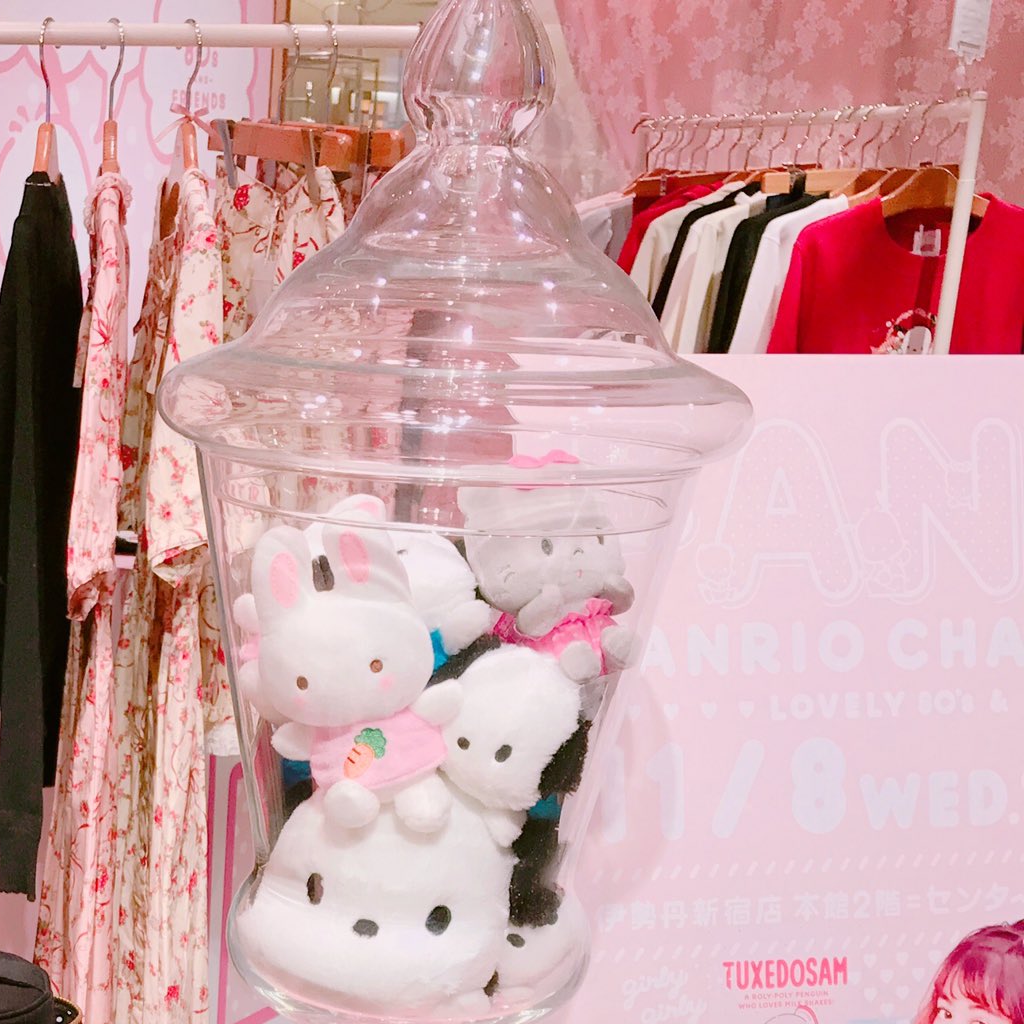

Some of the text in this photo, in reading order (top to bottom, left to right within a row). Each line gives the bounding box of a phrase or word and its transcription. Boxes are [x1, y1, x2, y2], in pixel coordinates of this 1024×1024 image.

[172, 89, 226, 110] FRENDS
[678, 416, 1024, 607] AN
[639, 619, 865, 677] ANRIO
[769, 690, 905, 721] LOVELY
[858, 768, 1021, 831] WED.
[722, 956, 848, 991] TUXEDOSAM
[758, 1001, 782, 1009] LOVES
[784, 1000, 801, 1008] MILK
[795, 990, 829, 999] PENGUIN
